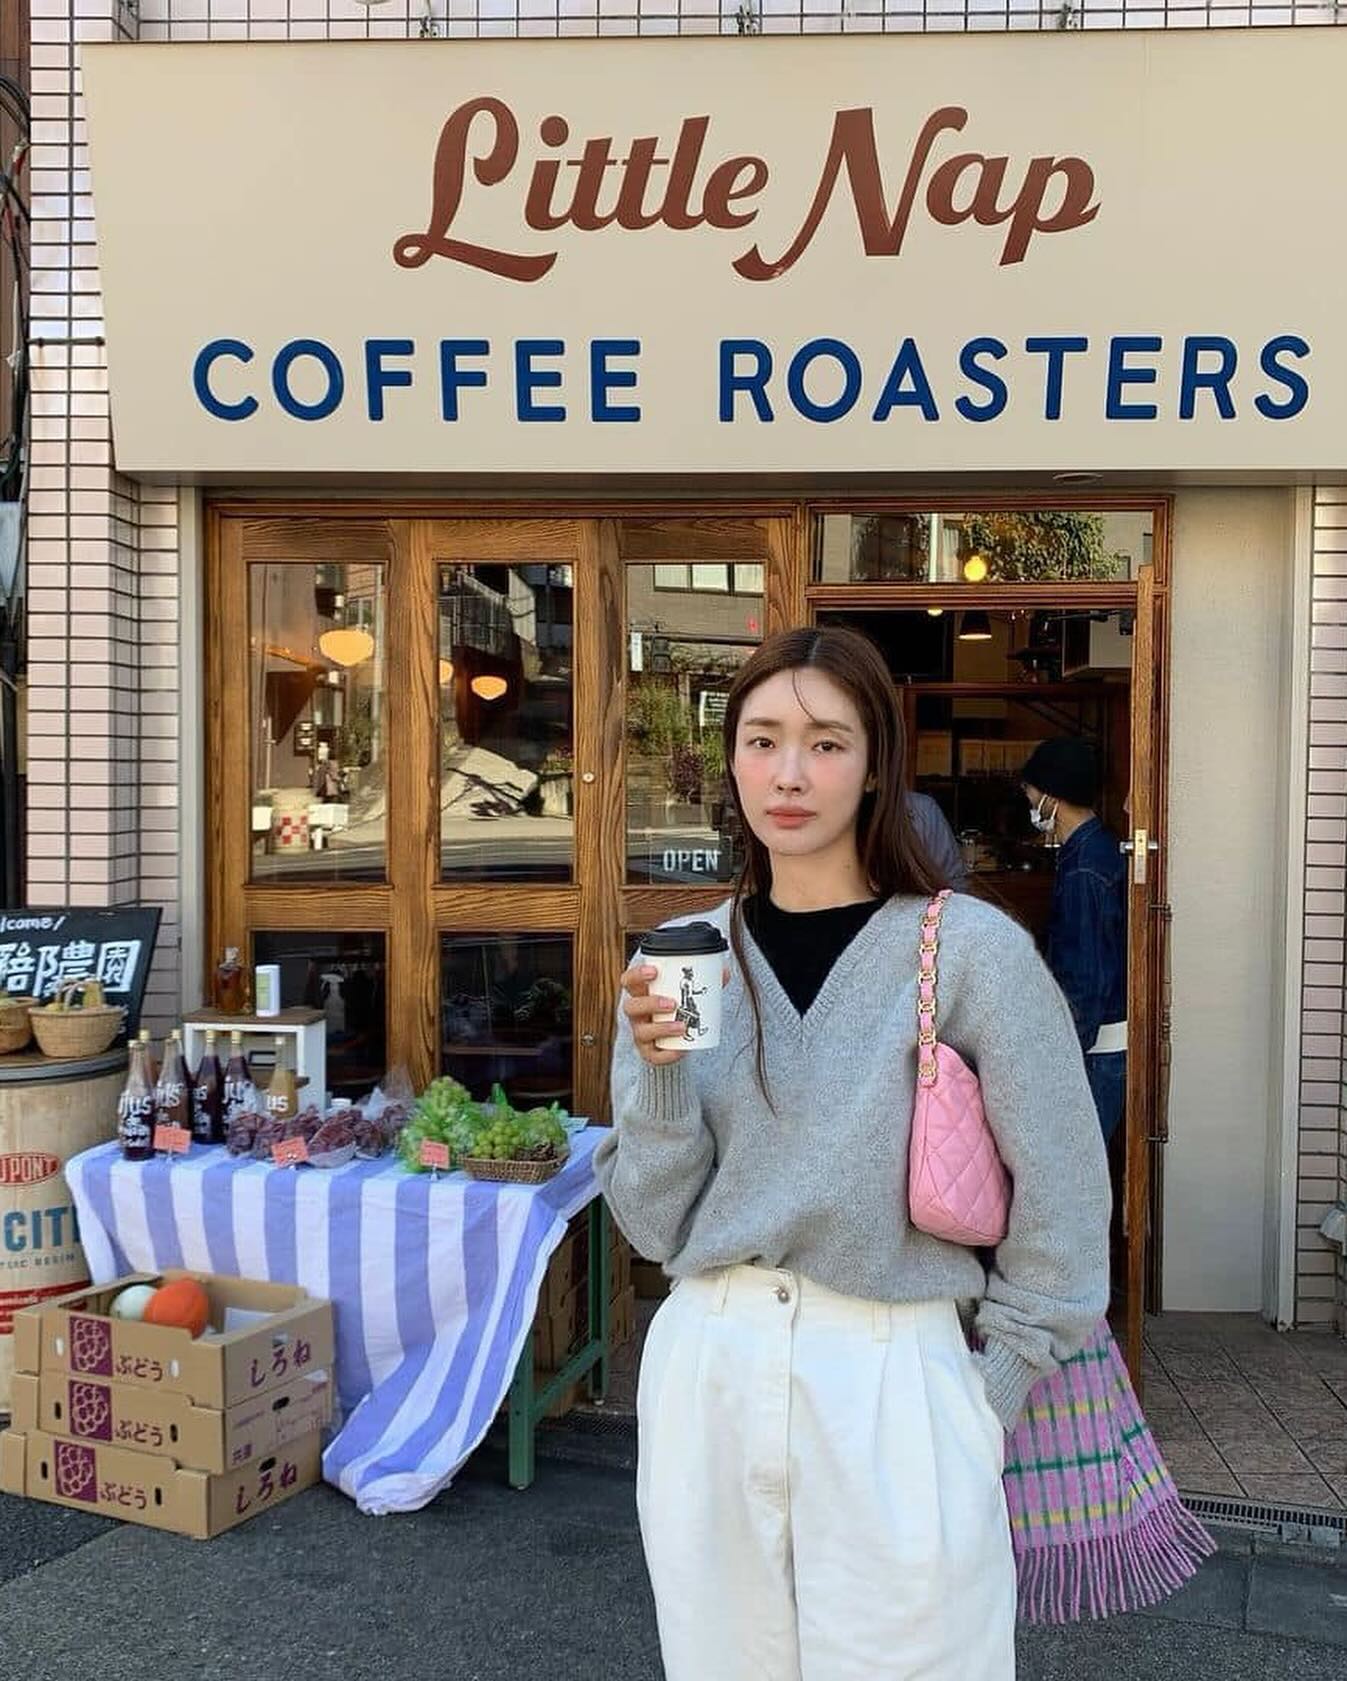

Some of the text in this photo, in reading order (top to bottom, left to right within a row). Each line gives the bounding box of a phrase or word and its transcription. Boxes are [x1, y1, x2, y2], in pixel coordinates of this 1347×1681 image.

[392, 96, 1102, 284] Little Nap
[192, 335, 1312, 423] COFFEE ROASTERS
[663, 849, 719, 872] OPEN
[116, 1354, 164, 1382] ぶどう
[250, 1340, 312, 1388] しろね
[116, 1419, 164, 1447] ぶどう
[100, 1482, 148, 1510] ぶどう
[235, 1461, 297, 1515] しろね
